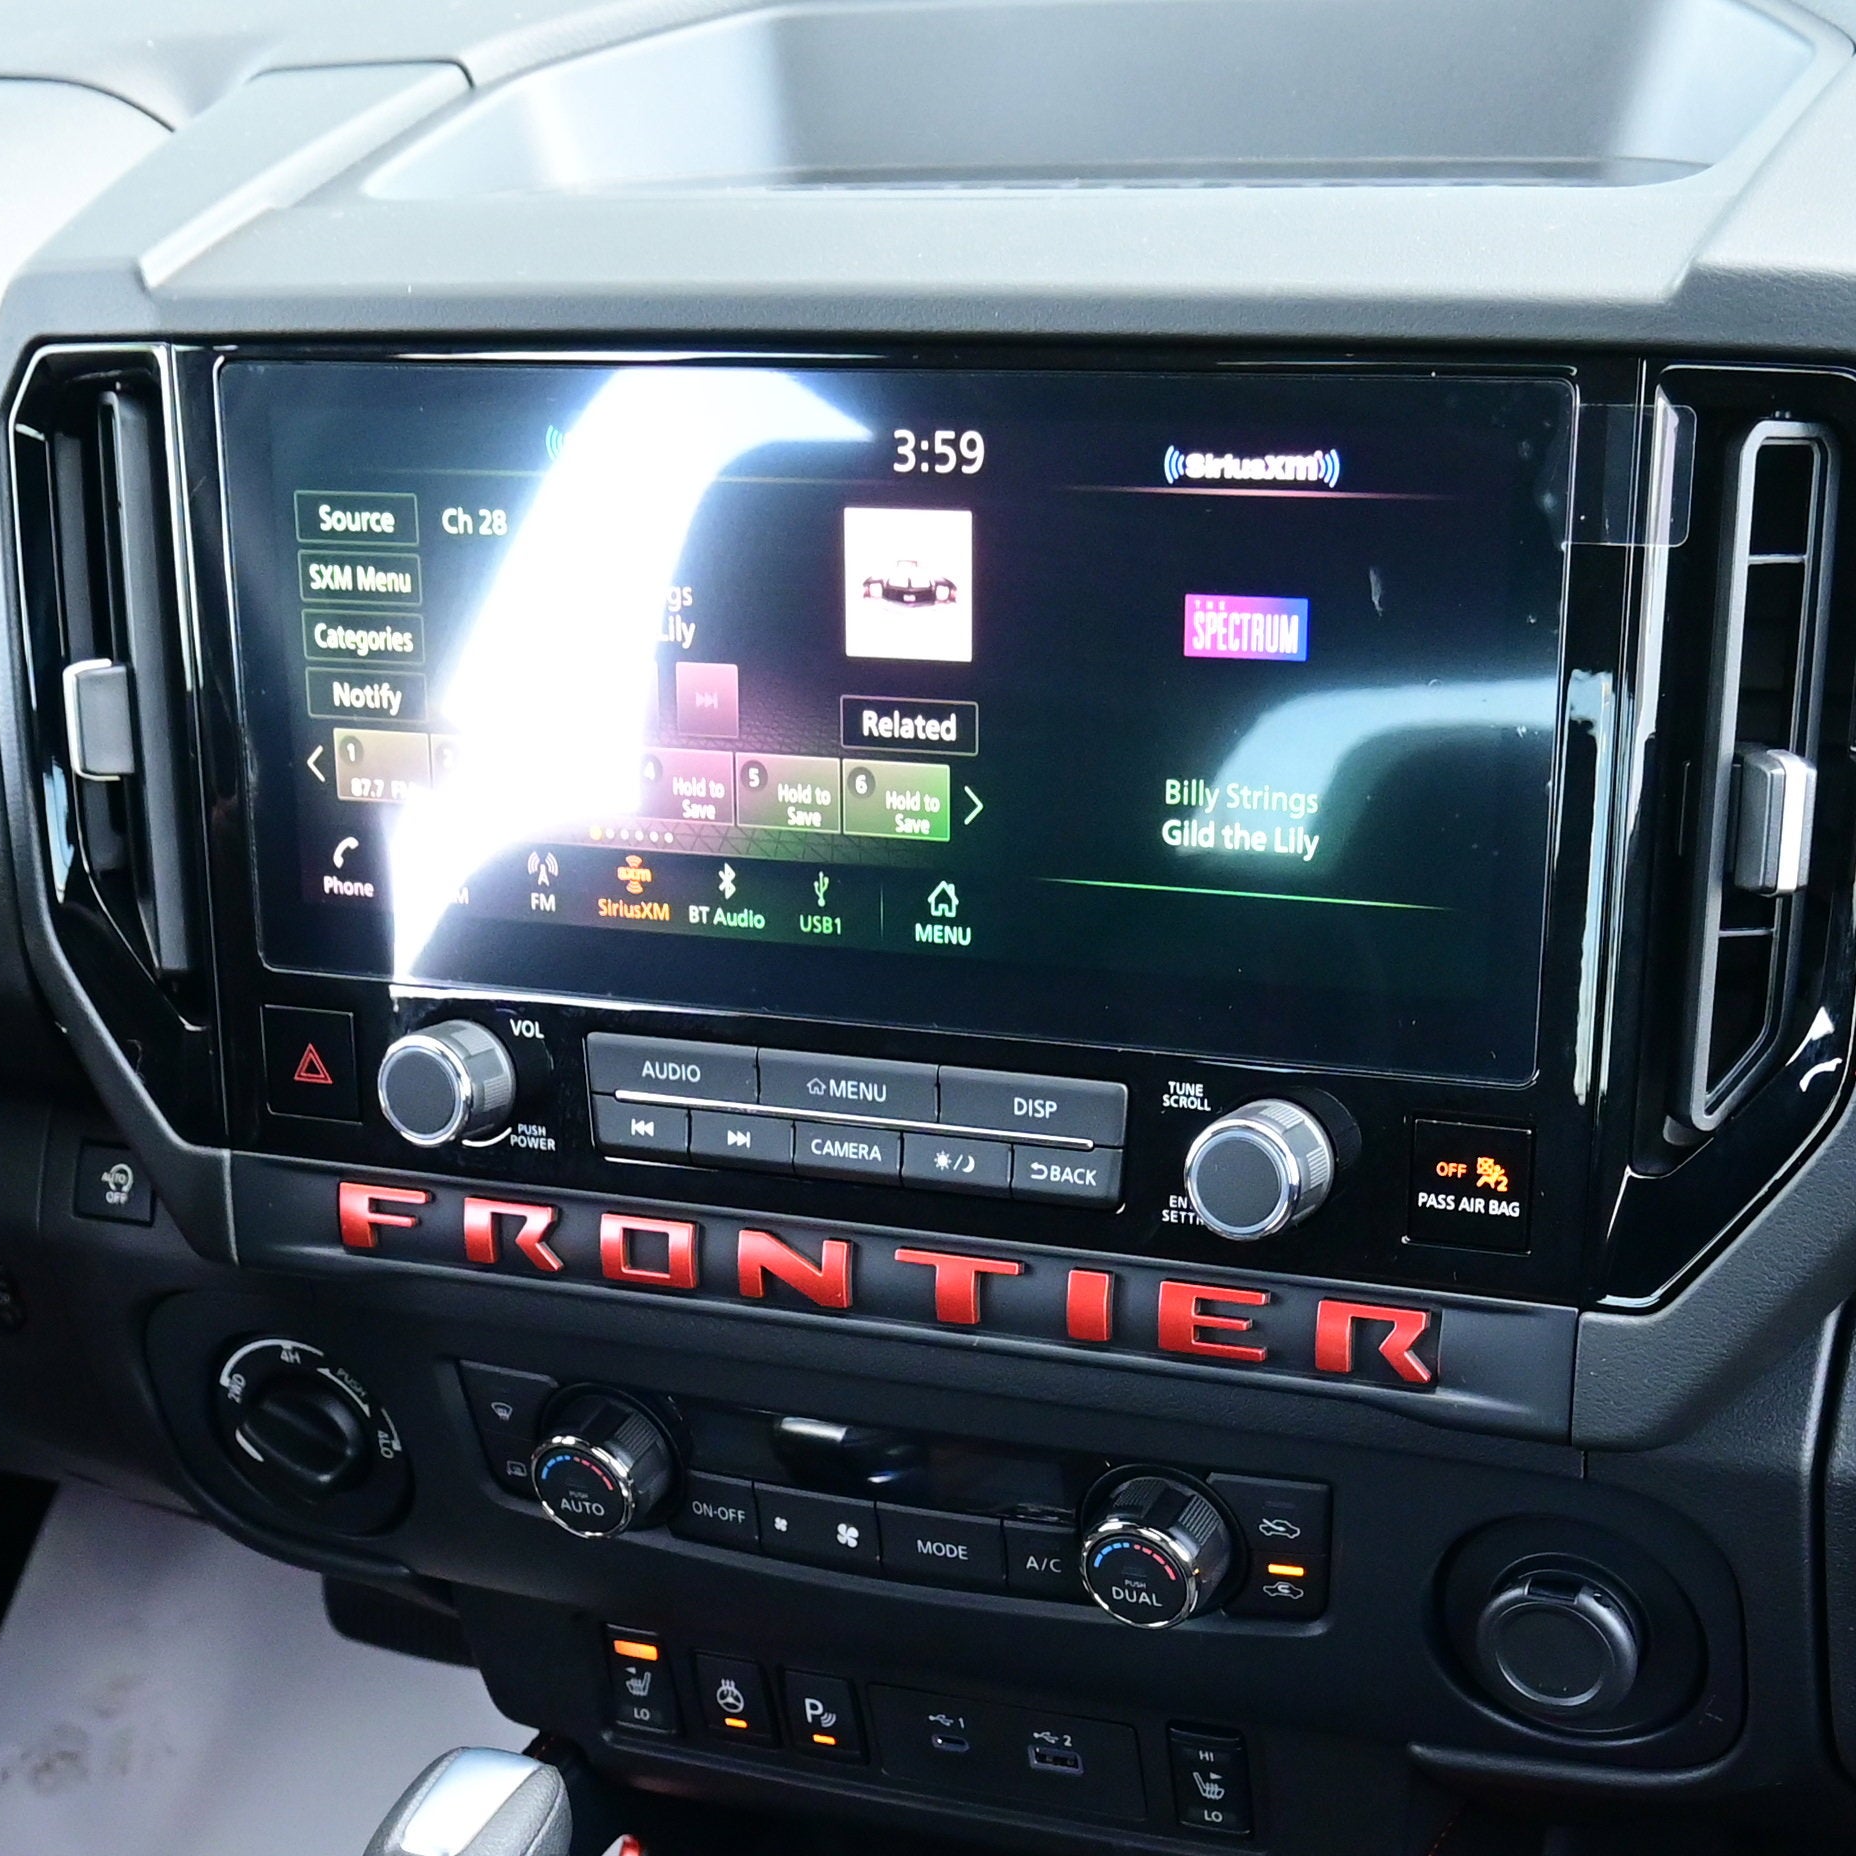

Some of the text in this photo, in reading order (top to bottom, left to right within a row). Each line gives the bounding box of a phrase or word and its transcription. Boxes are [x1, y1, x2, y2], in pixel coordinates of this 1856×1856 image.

[893, 429, 985, 474] 3:59
[318, 504, 395, 533] Source
[441, 507, 508, 535] Ch 28
[309, 563, 412, 593] SXM Menu
[314, 623, 414, 656] Categories
[1193, 611, 1300, 654] SPECTRUM
[332, 682, 402, 716] Notify
[861, 710, 958, 741] Related
[672, 778, 725, 799] Hold to
[748, 768, 760, 787] 5
[855, 774, 868, 794] 6
[777, 785, 831, 806] Hold to
[885, 791, 940, 814] Hold to
[1165, 778, 1319, 819] Billy Strings
[682, 800, 715, 820] Save
[787, 807, 821, 827] Save
[895, 813, 930, 835] Save
[1162, 818, 1320, 861] Gild the Lily
[323, 876, 374, 898] Phone
[530, 892, 556, 912] FM
[597, 898, 670, 921] SiriusXM
[688, 905, 765, 930] BT Audio
[799, 915, 842, 935] USB1
[914, 923, 972, 945] MENU
[510, 1018, 544, 1040] VOL
[641, 1059, 701, 1084] AUDIO
[829, 1080, 887, 1103] MENU
[1168, 1081, 1204, 1097] TUNE
[1013, 1097, 1058, 1119] DISP
[1162, 1094, 1211, 1111] SCROLL
[517, 1123, 547, 1137] PUSH
[510, 1133, 556, 1152] POWER
[811, 1139, 882, 1163] CAMERA
[1049, 1165, 1097, 1187] BACK
[1436, 1161, 1467, 1178] OFF
[106, 1191, 129, 1204] OFF
[1418, 1192, 1520, 1217] PASS AIR BAG
[339, 1181, 1436, 1387] FRONTIER
[280, 1350, 302, 1365] 4H
[227, 1373, 247, 1404] 2WD
[377, 1430, 394, 1459] 4LO
[560, 1498, 605, 1517] AUTO
[693, 1500, 746, 1523] ON-OFF
[916, 1539, 968, 1561] MODE
[1026, 1555, 1062, 1573] A/C
[1111, 1586, 1162, 1607] DUAL
[633, 1707, 650, 1721] LO
[1199, 1750, 1214, 1763] HI
[1203, 1809, 1223, 1823] LO
